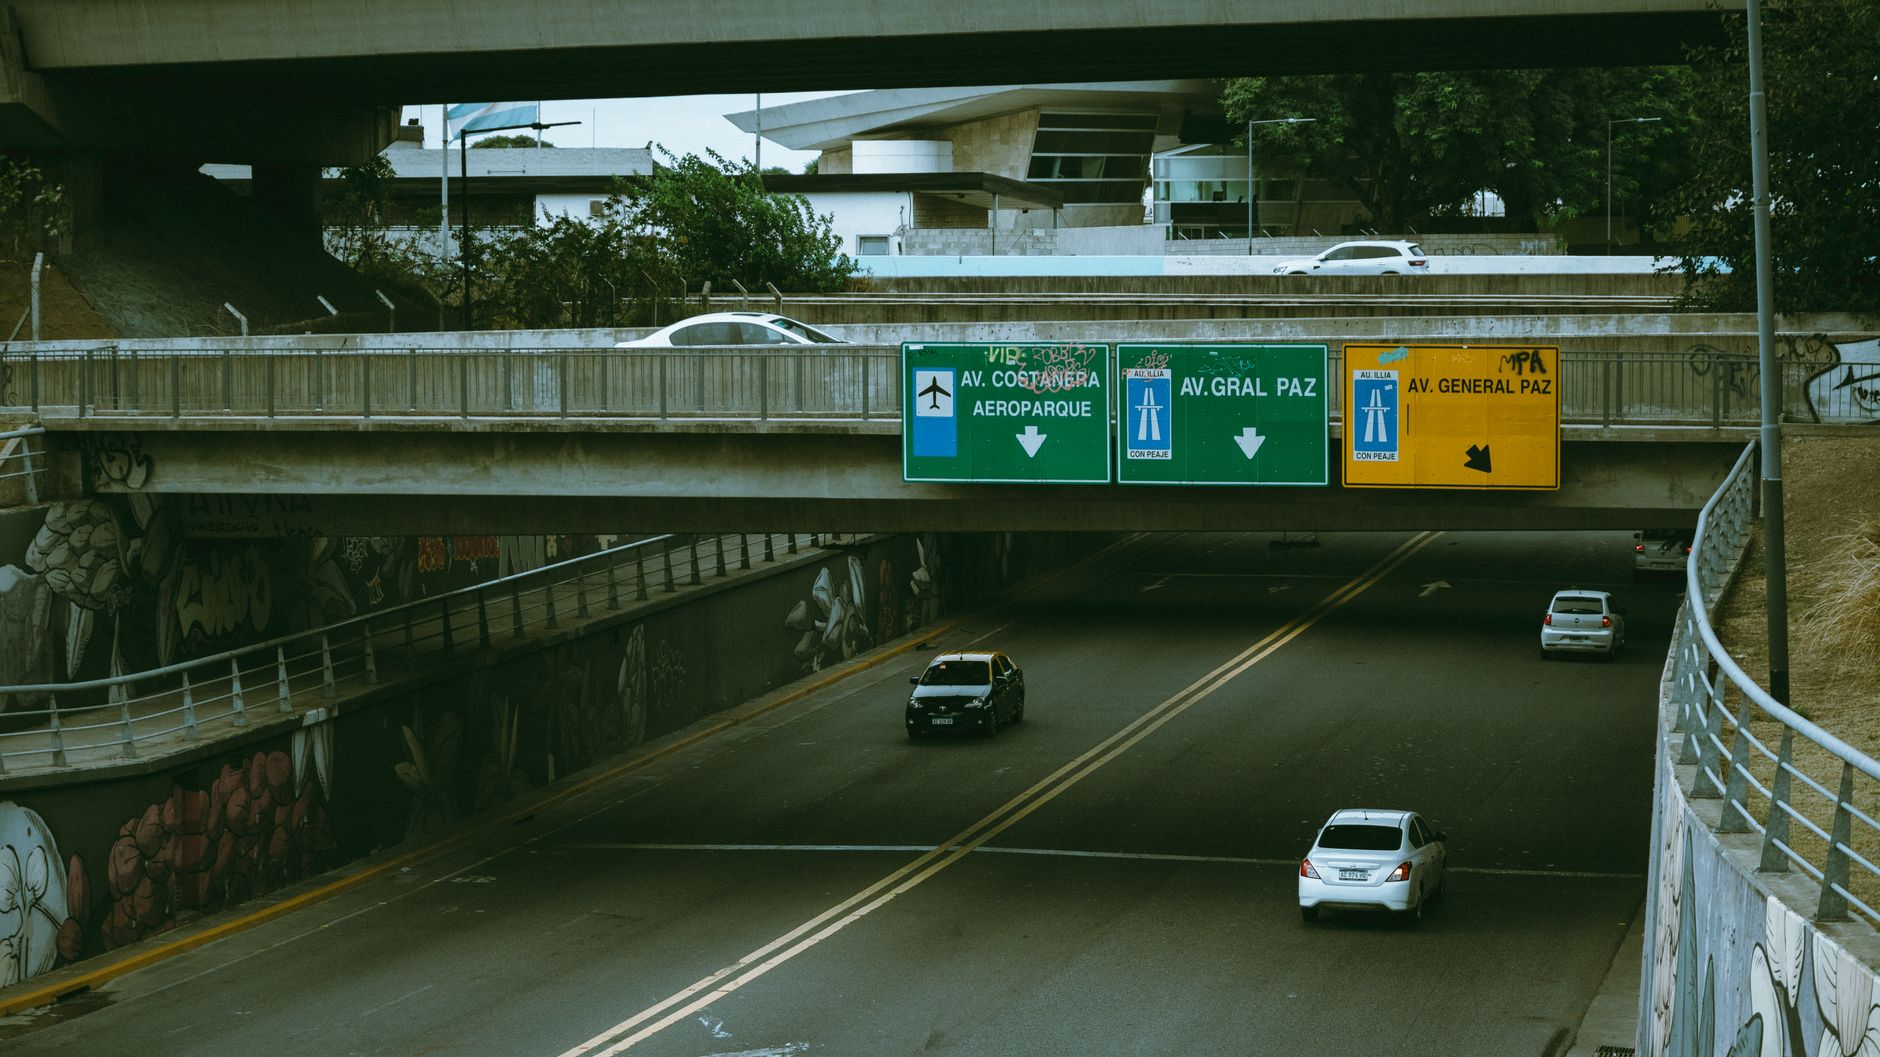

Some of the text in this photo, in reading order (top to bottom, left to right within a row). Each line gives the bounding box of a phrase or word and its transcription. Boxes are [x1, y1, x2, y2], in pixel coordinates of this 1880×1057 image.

[1498, 350, 1547, 376] MPA
[960, 370, 1100, 388] AV. COSTANERA
[1360, 371, 1392, 379] AU. ILLIA
[1276, 378, 1317, 397] PAZ
[1408, 378, 1552, 395] AV. GENERAL PAZ
[972, 400, 1092, 417] AEROPARQUE
[1129, 451, 1169, 459] CON PEAJE
[1356, 452, 1396, 461] CON PEAJE
